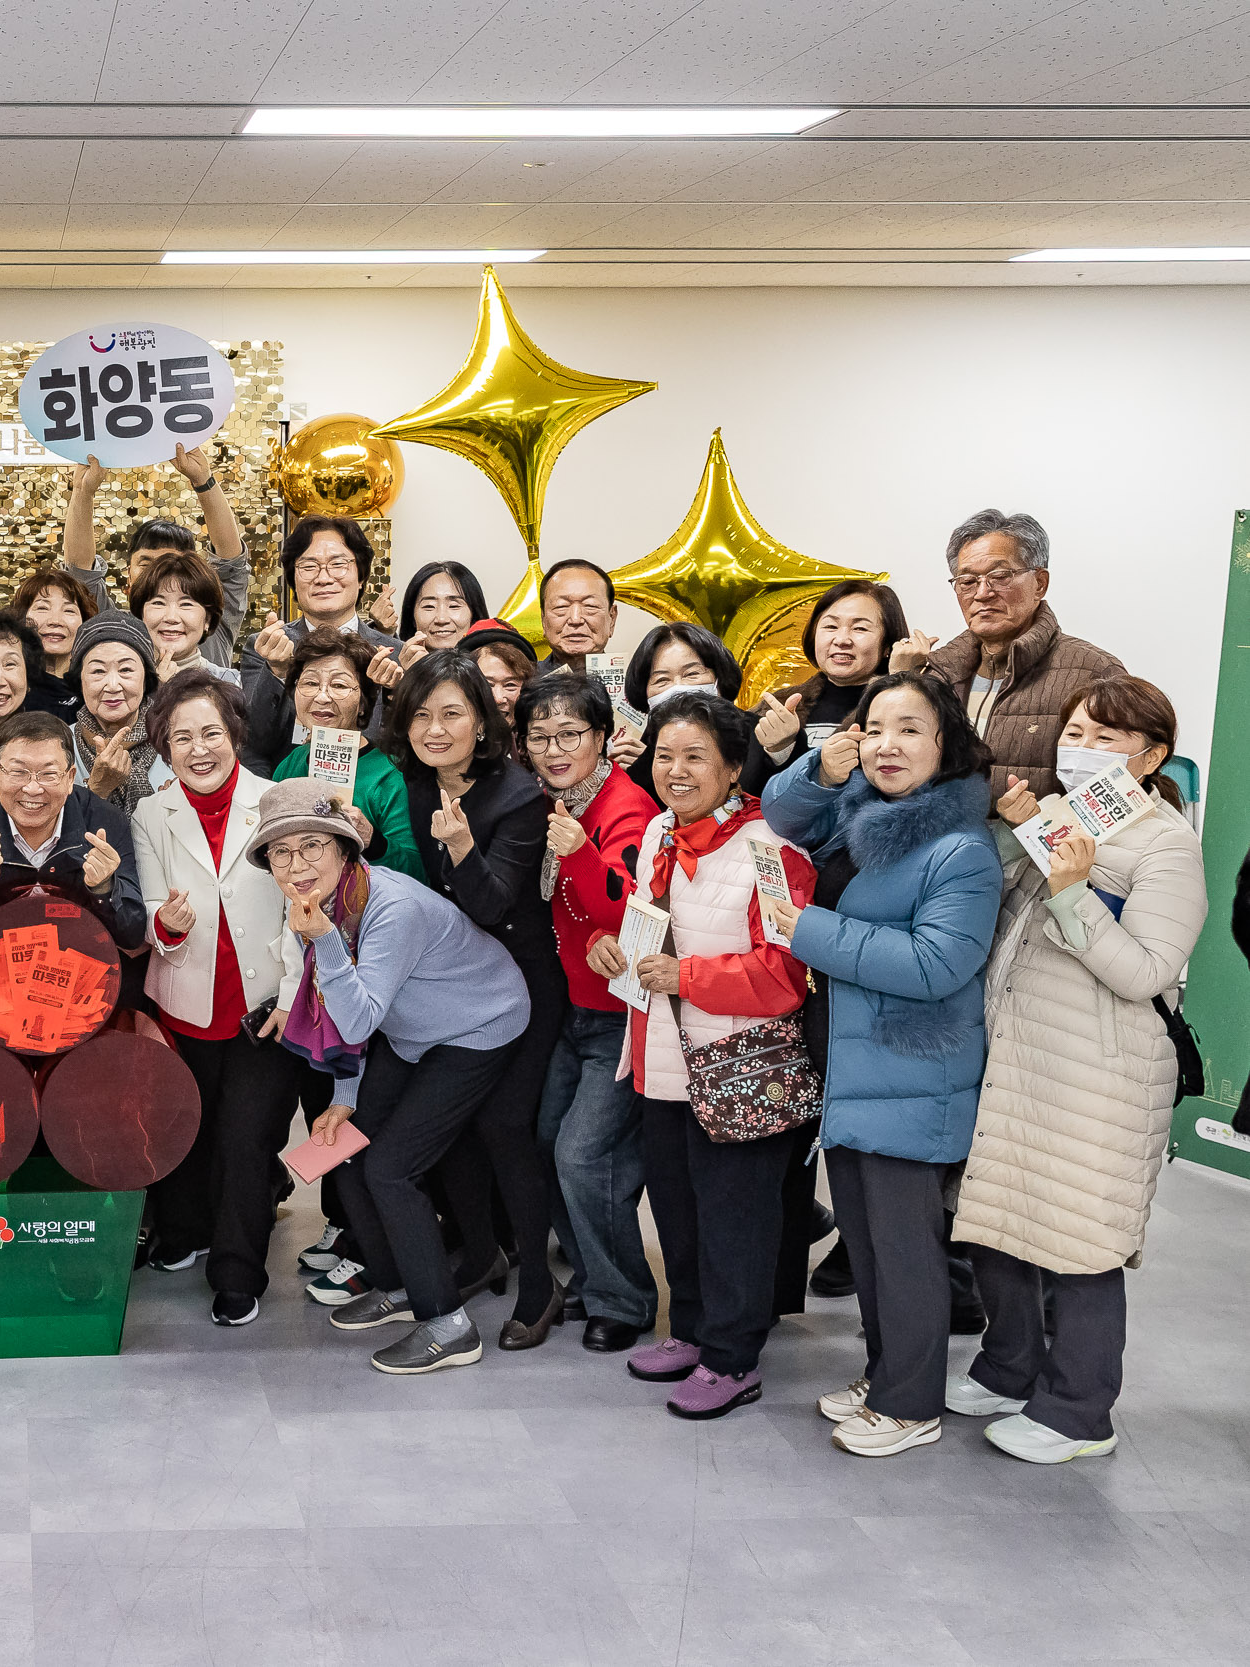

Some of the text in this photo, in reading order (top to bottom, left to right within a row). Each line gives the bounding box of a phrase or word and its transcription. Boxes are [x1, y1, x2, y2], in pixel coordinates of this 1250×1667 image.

[119, 337, 156, 351] 행복광진
[39, 356, 215, 442] 화양동
[315, 749, 352, 763] 따뜻한
[314, 760, 350, 772] 겨울나기
[1101, 777, 1115, 792] 2026
[1080, 789, 1114, 828] 겨울나기
[1089, 781, 1126, 822] 따뜻한
[756, 861, 783, 879] 따뜻한
[758, 873, 784, 888] 겨울나기
[32, 970, 70, 988] 따뜻한
[17, 1220, 95, 1237] 사랑의 열매
